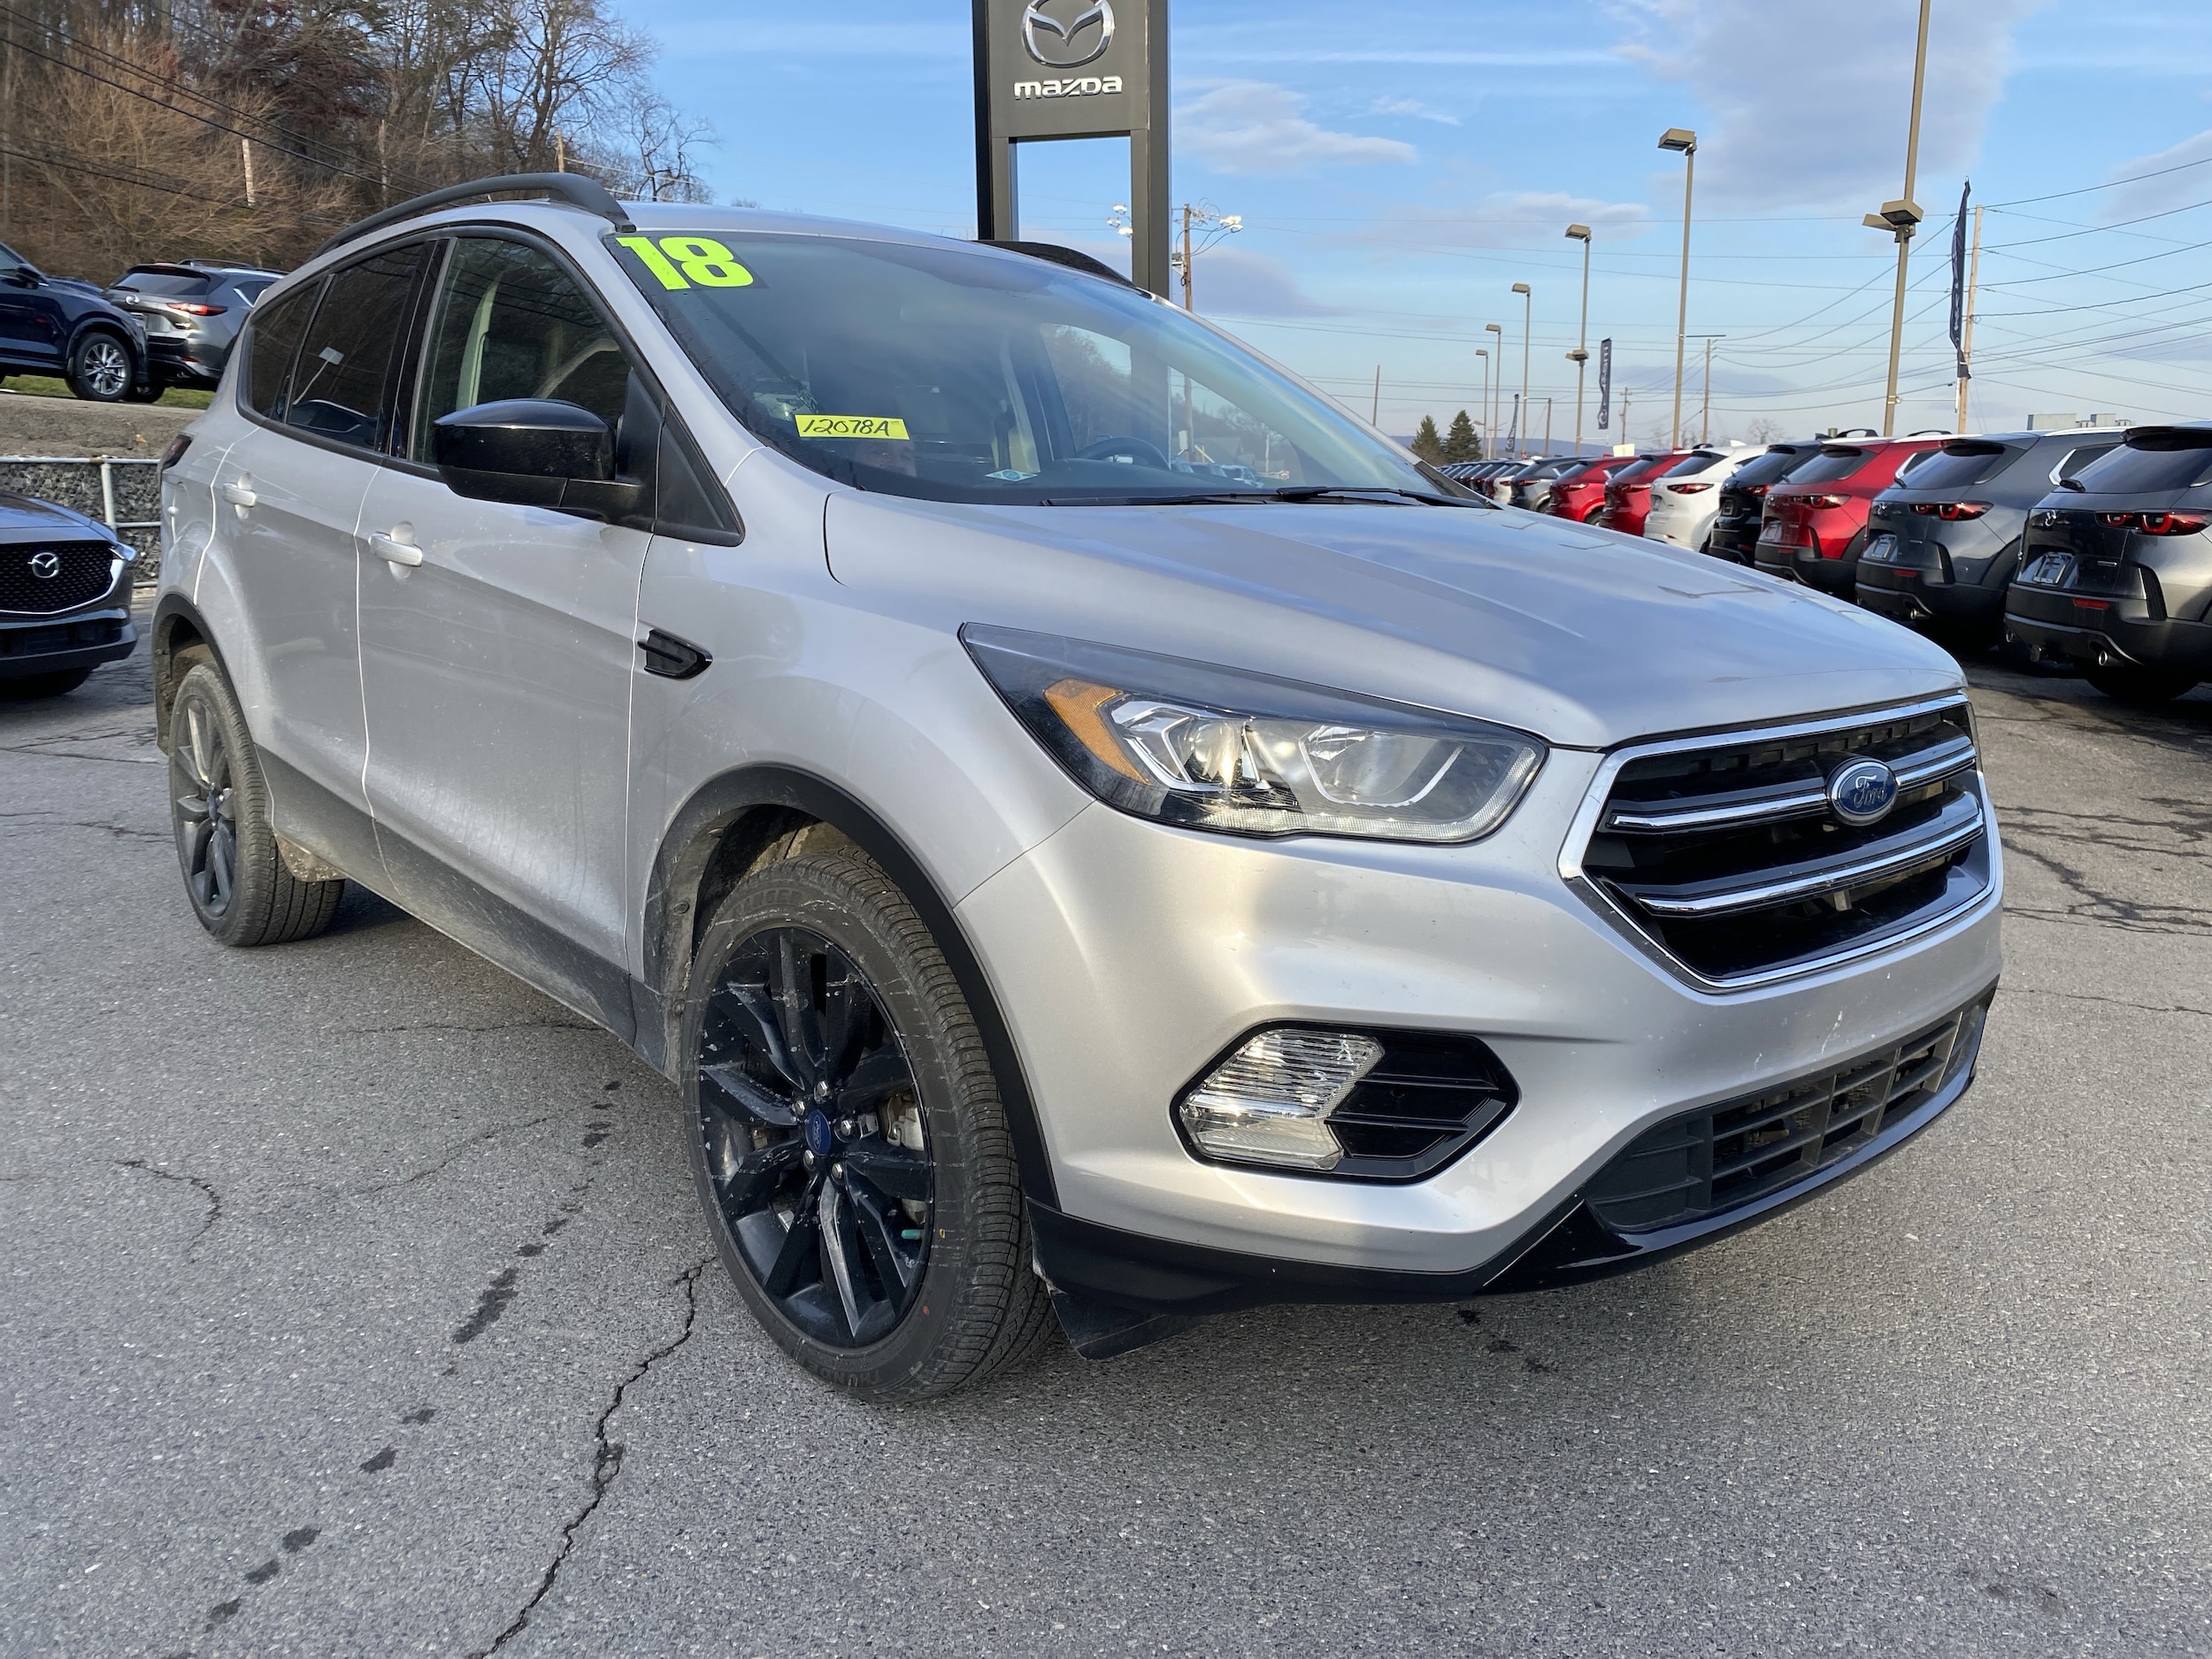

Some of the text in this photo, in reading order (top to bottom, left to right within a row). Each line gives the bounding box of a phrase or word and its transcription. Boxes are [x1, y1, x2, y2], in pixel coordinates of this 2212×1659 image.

[1014, 75, 1123, 100] mazda
[615, 236, 754, 290] 18
[803, 419, 890, 436] 12078A
[1853, 774, 1888, 809] Ford
